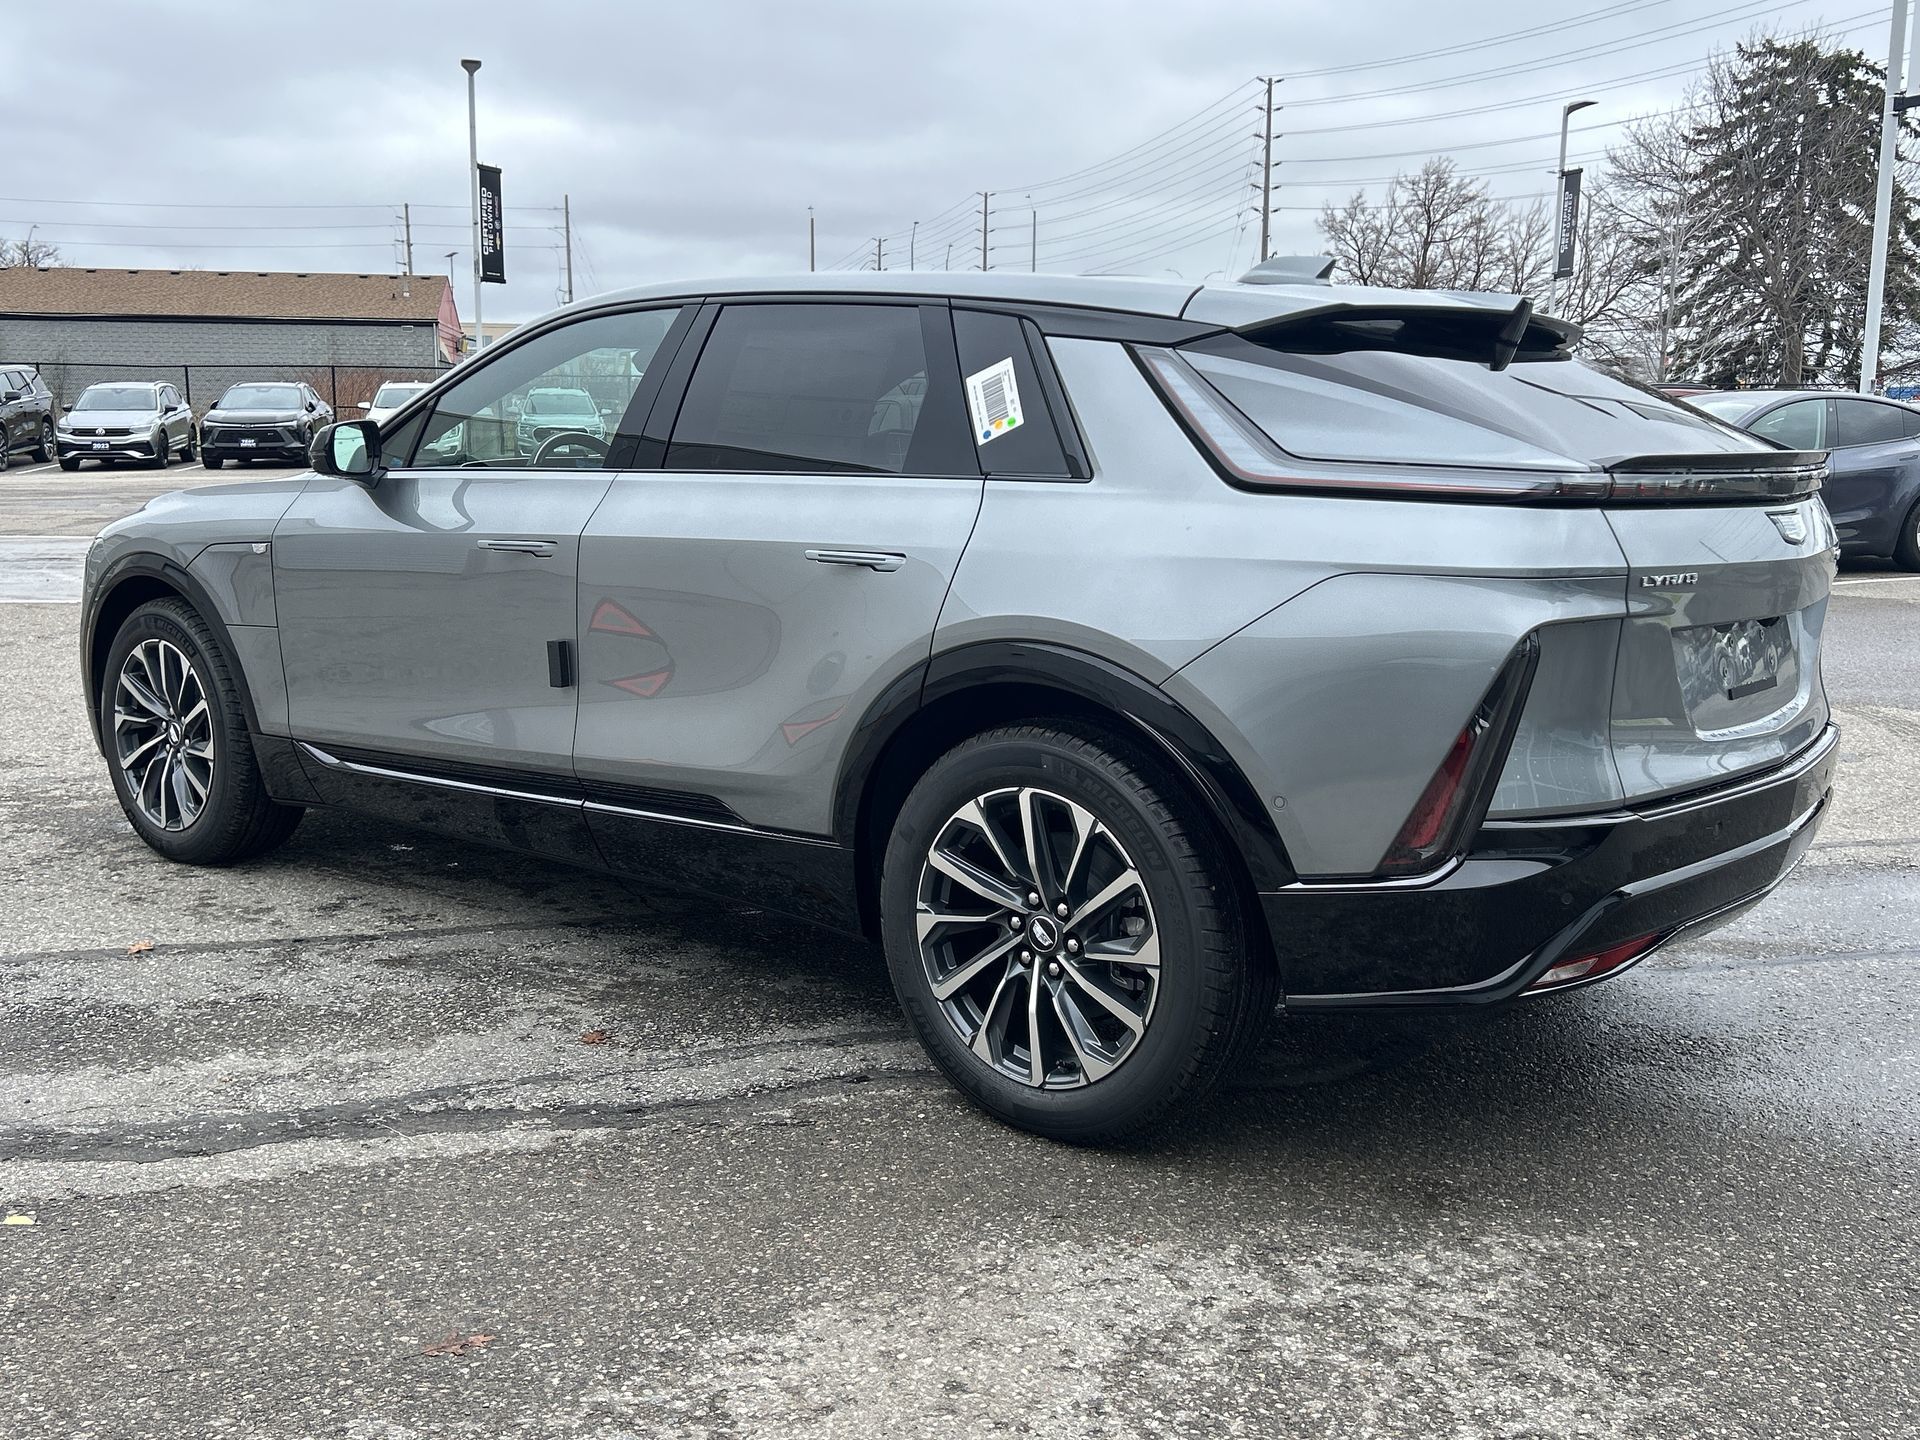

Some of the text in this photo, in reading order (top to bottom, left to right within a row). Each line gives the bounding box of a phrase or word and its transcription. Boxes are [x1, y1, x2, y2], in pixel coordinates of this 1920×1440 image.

[481, 187, 489, 255] CERTIFIED
[486, 191, 494, 253] PRE-OWNED
[1641, 572, 1698, 587] LYRIQ
